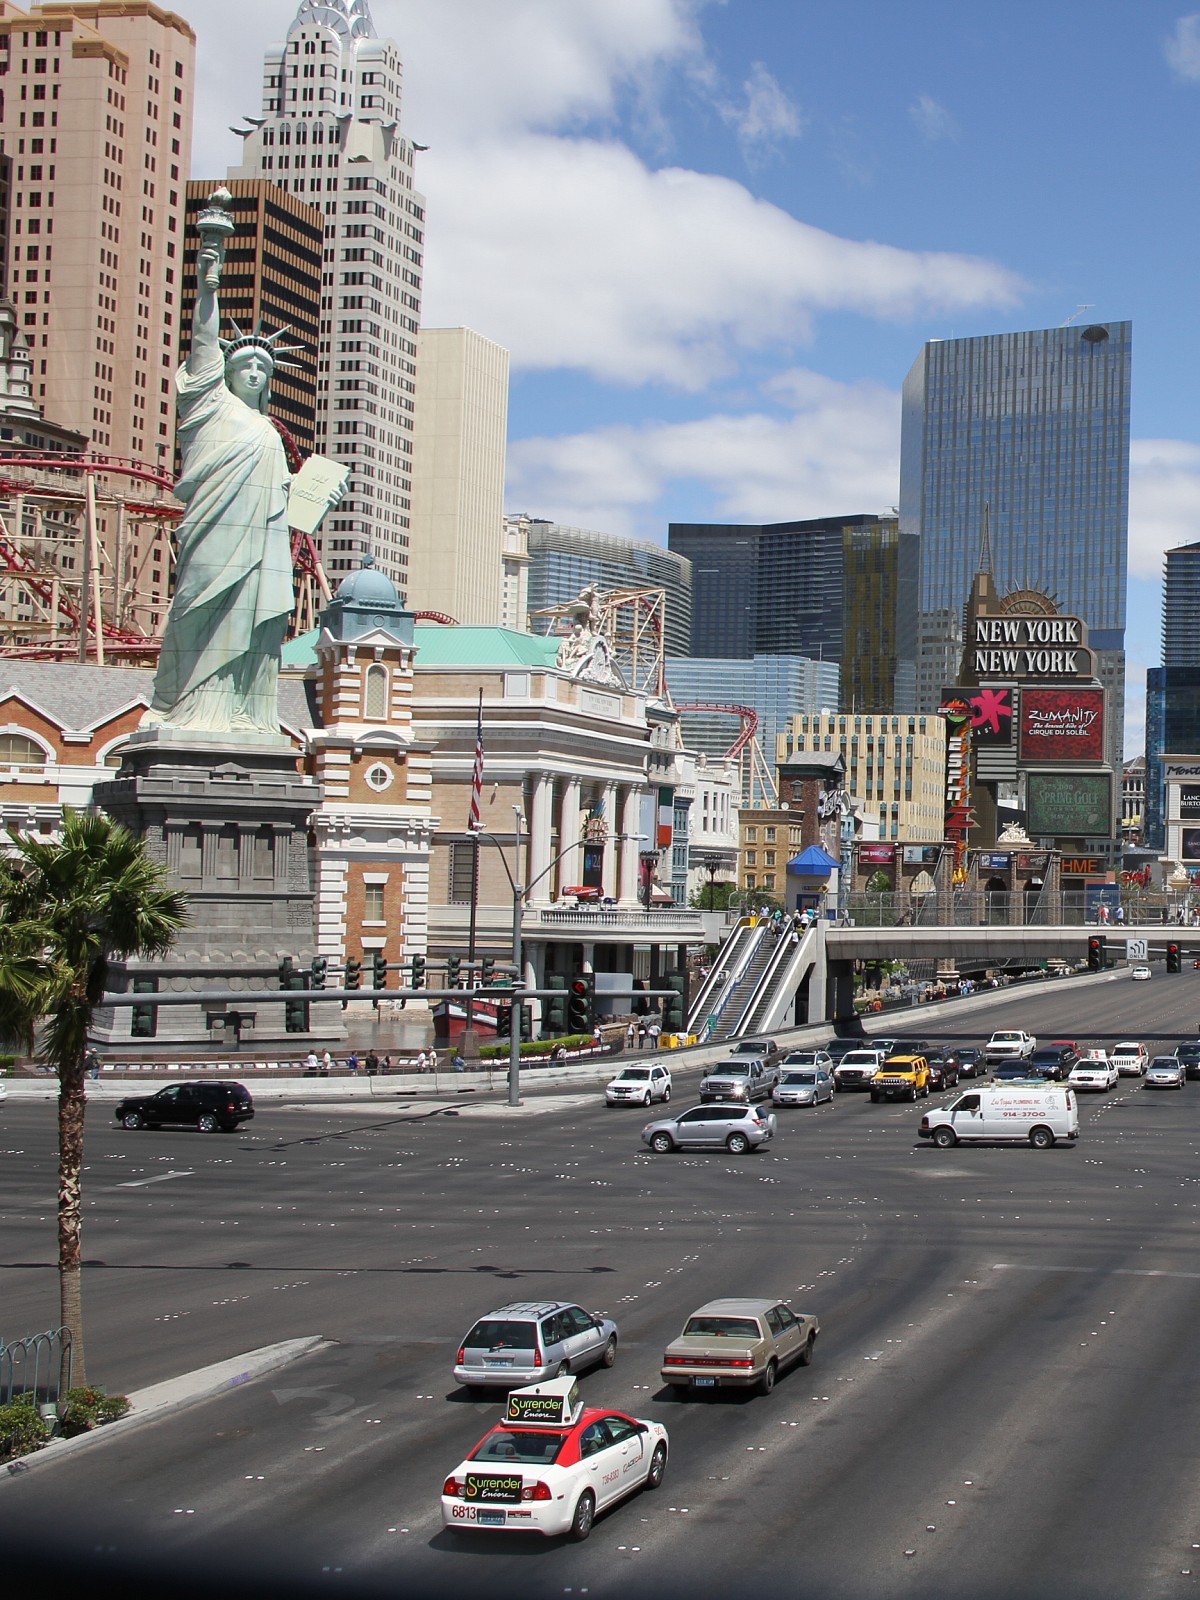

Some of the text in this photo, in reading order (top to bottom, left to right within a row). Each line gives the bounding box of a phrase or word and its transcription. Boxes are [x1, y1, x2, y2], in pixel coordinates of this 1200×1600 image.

[975, 620, 1079, 643] NEW YORK
[974, 649, 1078, 672] NEW YORK
[1028, 706, 1098, 728] ZUMANITY
[1039, 790, 1099, 804] SPRING GOLF
[1061, 860, 1098, 873] HME
[509, 1397, 562, 1416] Surrender
[523, 1408, 556, 1418] Encore
[466, 1476, 522, 1497] Surrender
[481, 1488, 515, 1498] Encore
[452, 1505, 476, 1519] 6813
